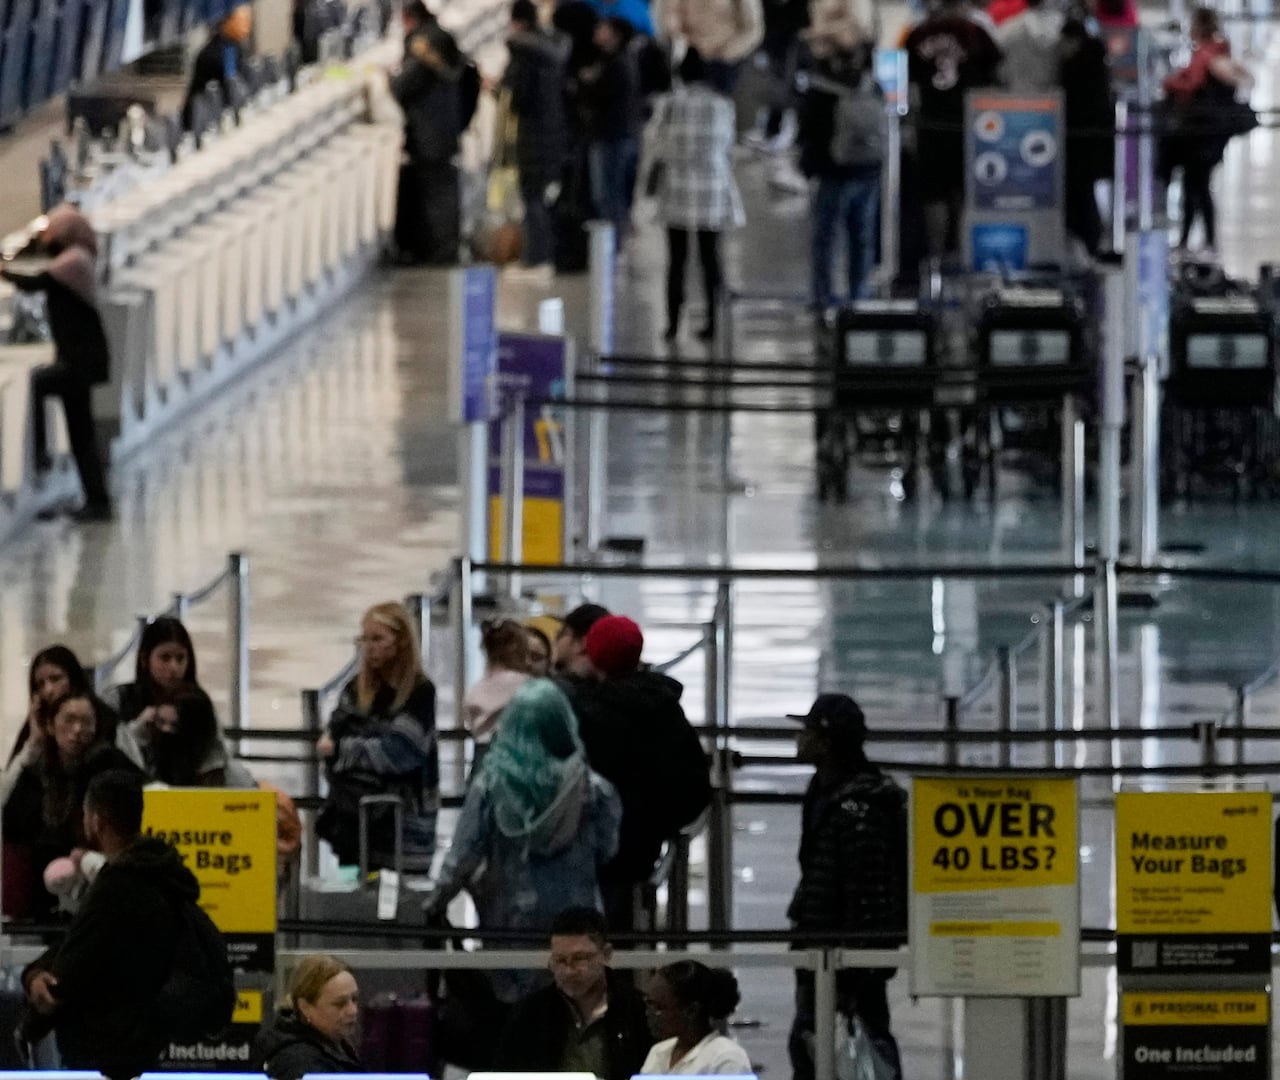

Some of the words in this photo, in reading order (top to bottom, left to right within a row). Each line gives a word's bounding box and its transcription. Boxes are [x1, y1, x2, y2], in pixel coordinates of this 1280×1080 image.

[973, 786, 1003, 798] Your
[1007, 786, 1031, 800] Bag
[934, 803, 1056, 838] OVER
[1131, 832, 1228, 850] Measure
[195, 850, 252, 875] Bags
[932, 846, 970, 871] 40
[981, 846, 1057, 871] LBS?
[1131, 855, 1185, 874] Your
[1191, 854, 1247, 879] Bags
[1150, 1002, 1219, 1014] PERSONAL
[1223, 1001, 1257, 1014] ITEM
[169, 1042, 251, 1061] Included
[1134, 1046, 1172, 1063] One
[1176, 1045, 1257, 1063] Included
